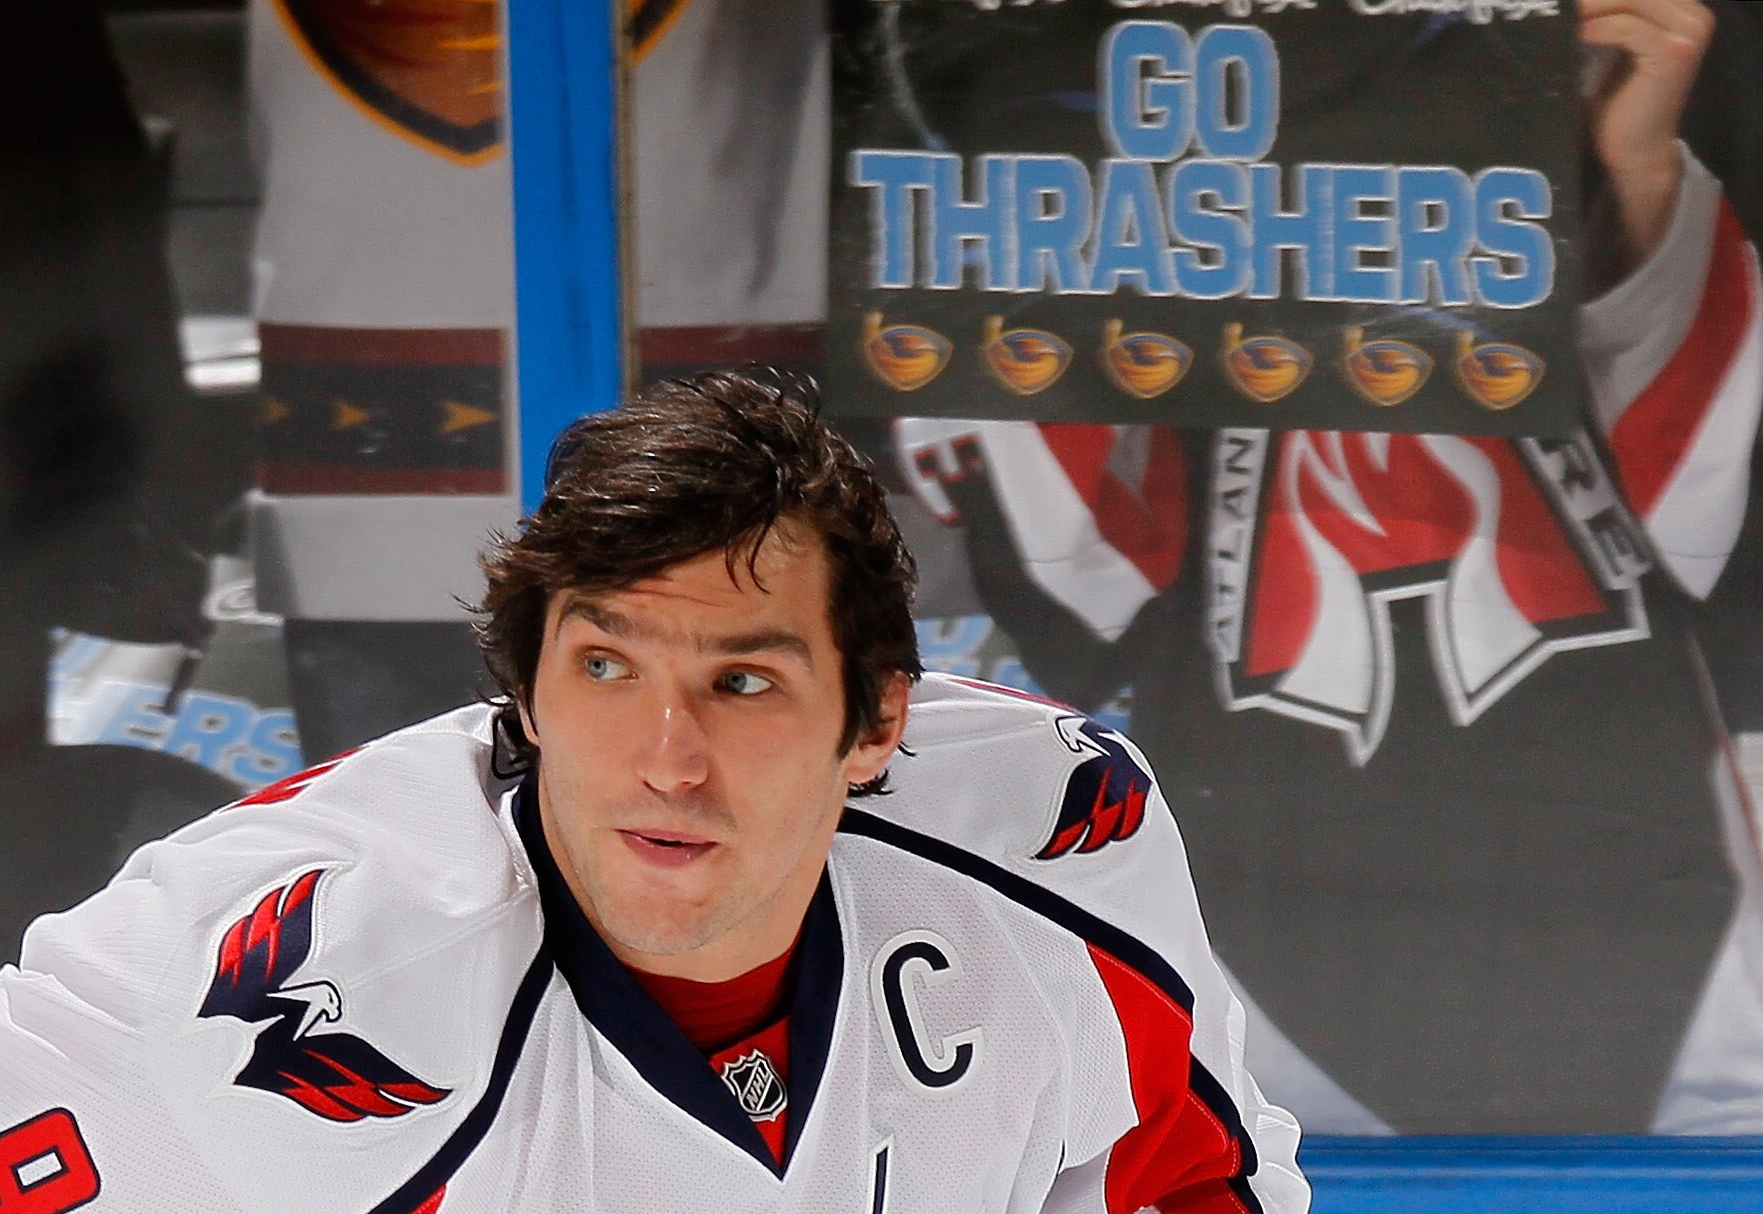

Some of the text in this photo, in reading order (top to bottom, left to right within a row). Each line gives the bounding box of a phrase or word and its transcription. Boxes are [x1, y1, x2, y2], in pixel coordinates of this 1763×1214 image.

[1100, 20, 1280, 163] GO
[848, 149, 1555, 309] THRASHERS
[880, 938, 977, 1090] C
[744, 1065, 772, 1111] NHL
